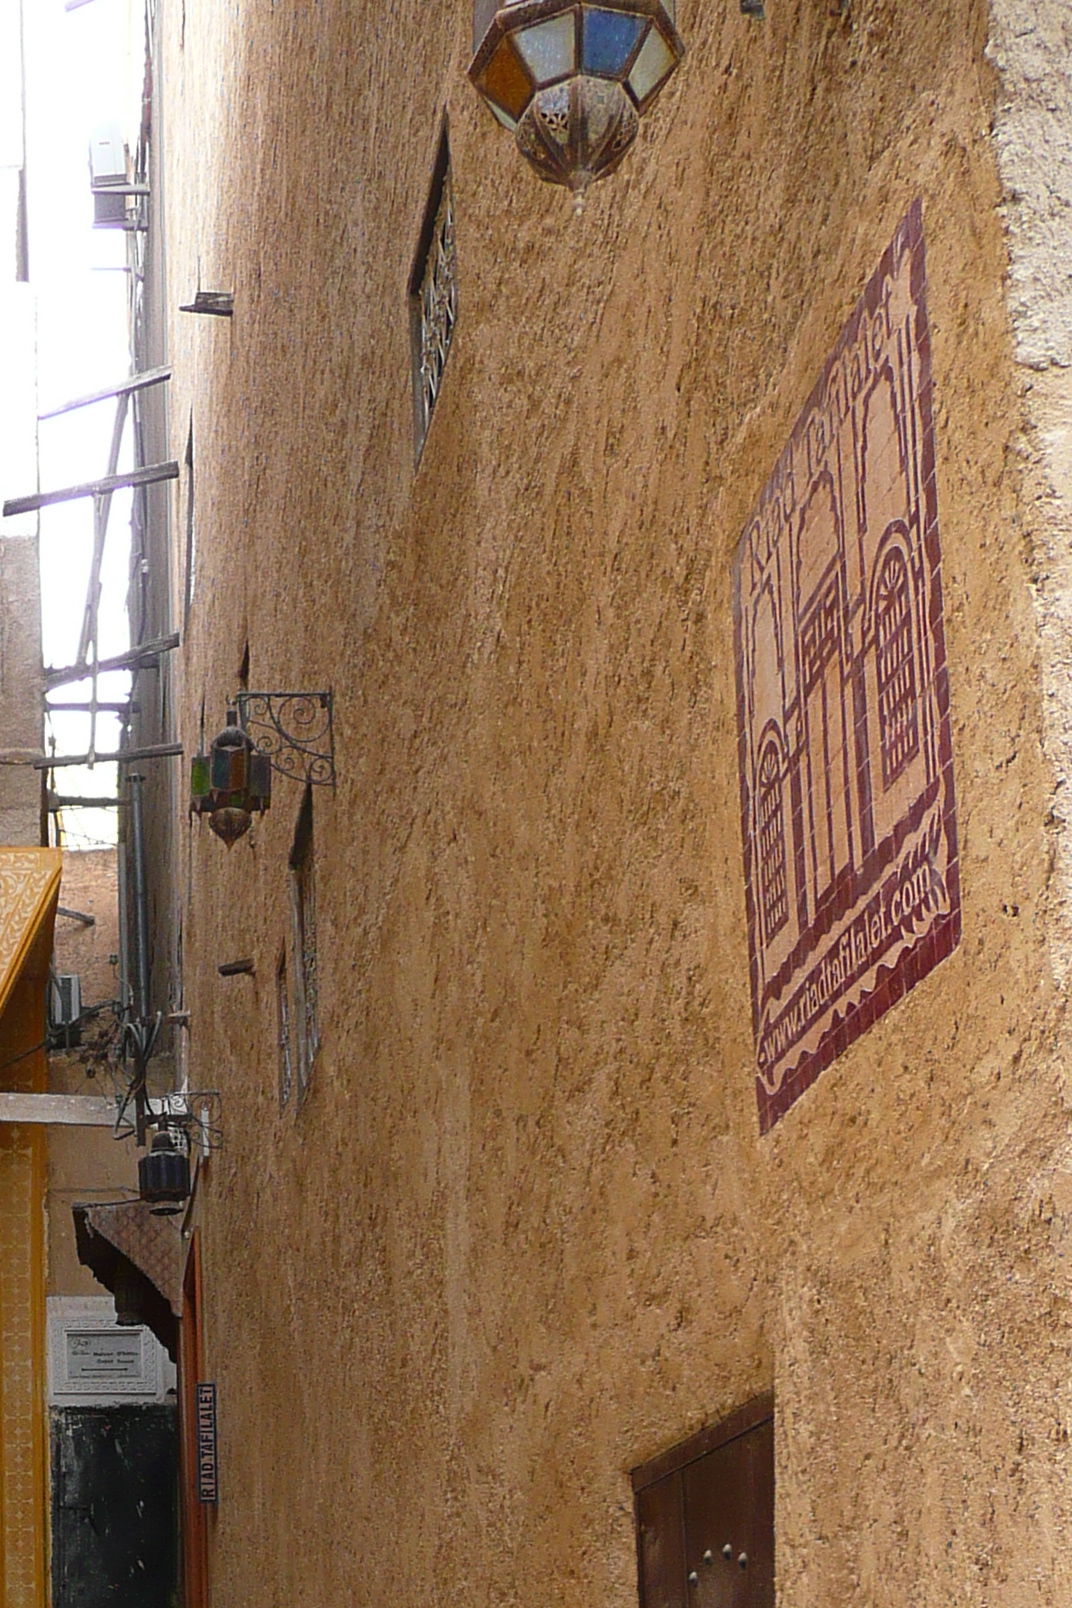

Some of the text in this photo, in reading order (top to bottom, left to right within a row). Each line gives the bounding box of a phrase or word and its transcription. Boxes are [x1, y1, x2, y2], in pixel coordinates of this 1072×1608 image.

[748, 274, 894, 597] Riad Tafilalet
[763, 861, 933, 1064] www.riadtafilalet.com
[199, 1387, 215, 1499] RIAD TAFILALET
